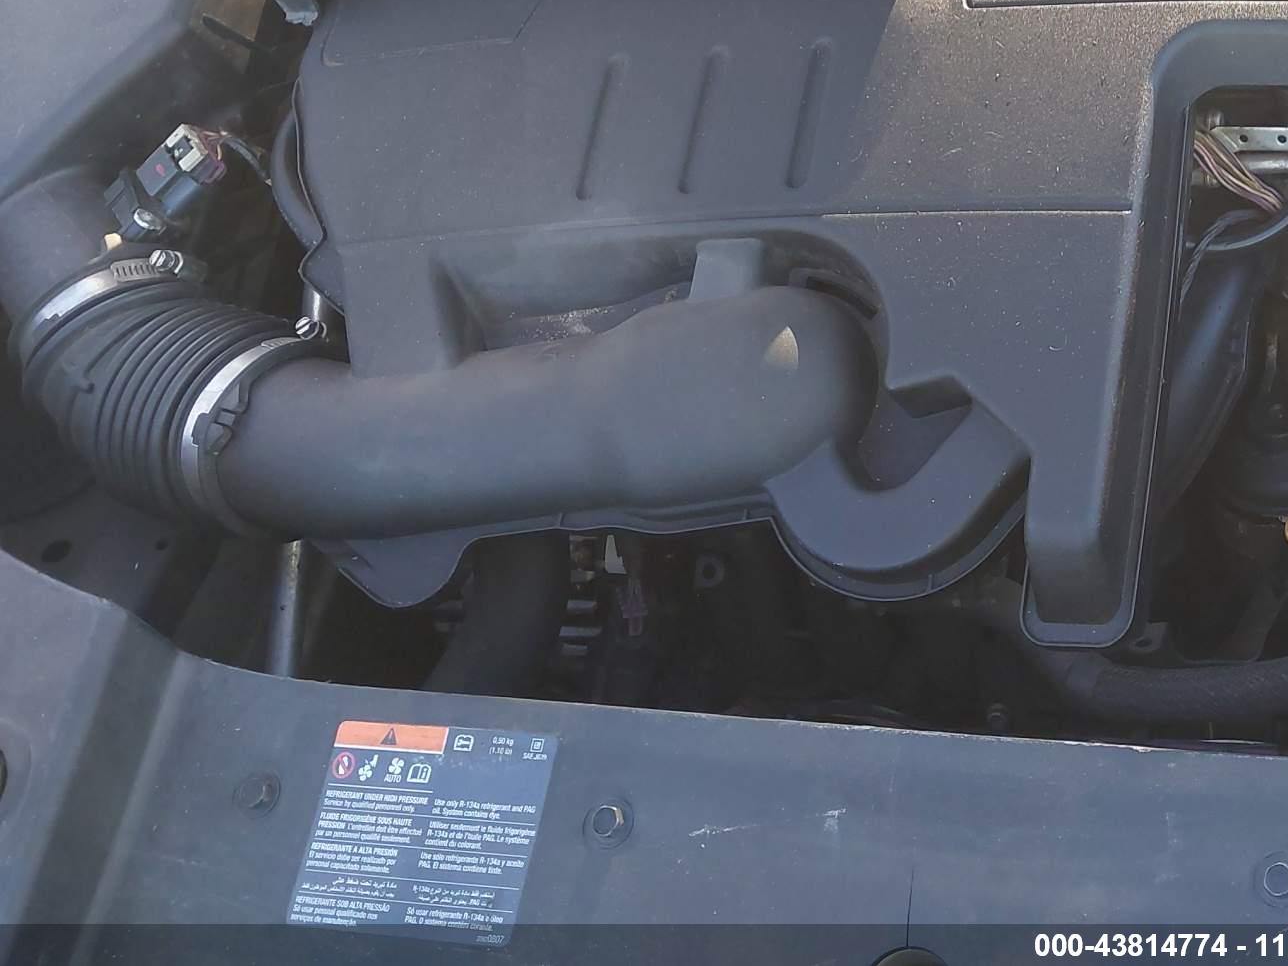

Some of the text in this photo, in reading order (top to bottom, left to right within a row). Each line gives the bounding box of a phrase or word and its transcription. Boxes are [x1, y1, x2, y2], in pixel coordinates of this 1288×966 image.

[506, 737, 514, 746] kg
[384, 774, 401, 783] AUTO
[326, 790, 429, 805] REFRIGERANT UNDER HIGH PRESSURE
[324, 798, 344, 807] Service
[344, 800, 352, 808] by
[352, 801, 376, 810] qualified
[375, 803, 401, 812] personnel
[434, 798, 446, 806] Use
[446, 800, 458, 808] only
[459, 800, 480, 809] R-134a
[481, 801, 511, 812] refrigerant
[524, 805, 536, 814] PAG
[320, 812, 340, 820] FLUIDE
[377, 816, 393, 825] SOUS
[393, 818, 413, 827] HAUTE
[442, 808, 463, 817] System
[464, 810, 489, 818] contains
[311, 842, 352, 853] REFRIGERANTE
[352, 845, 358, 853] A
[358, 846, 373, 855] ALTA
[296, 895, 337, 907] REFRIGERANTE
[336, 900, 349, 908] SOB
[349, 901, 363, 909] ALTA
